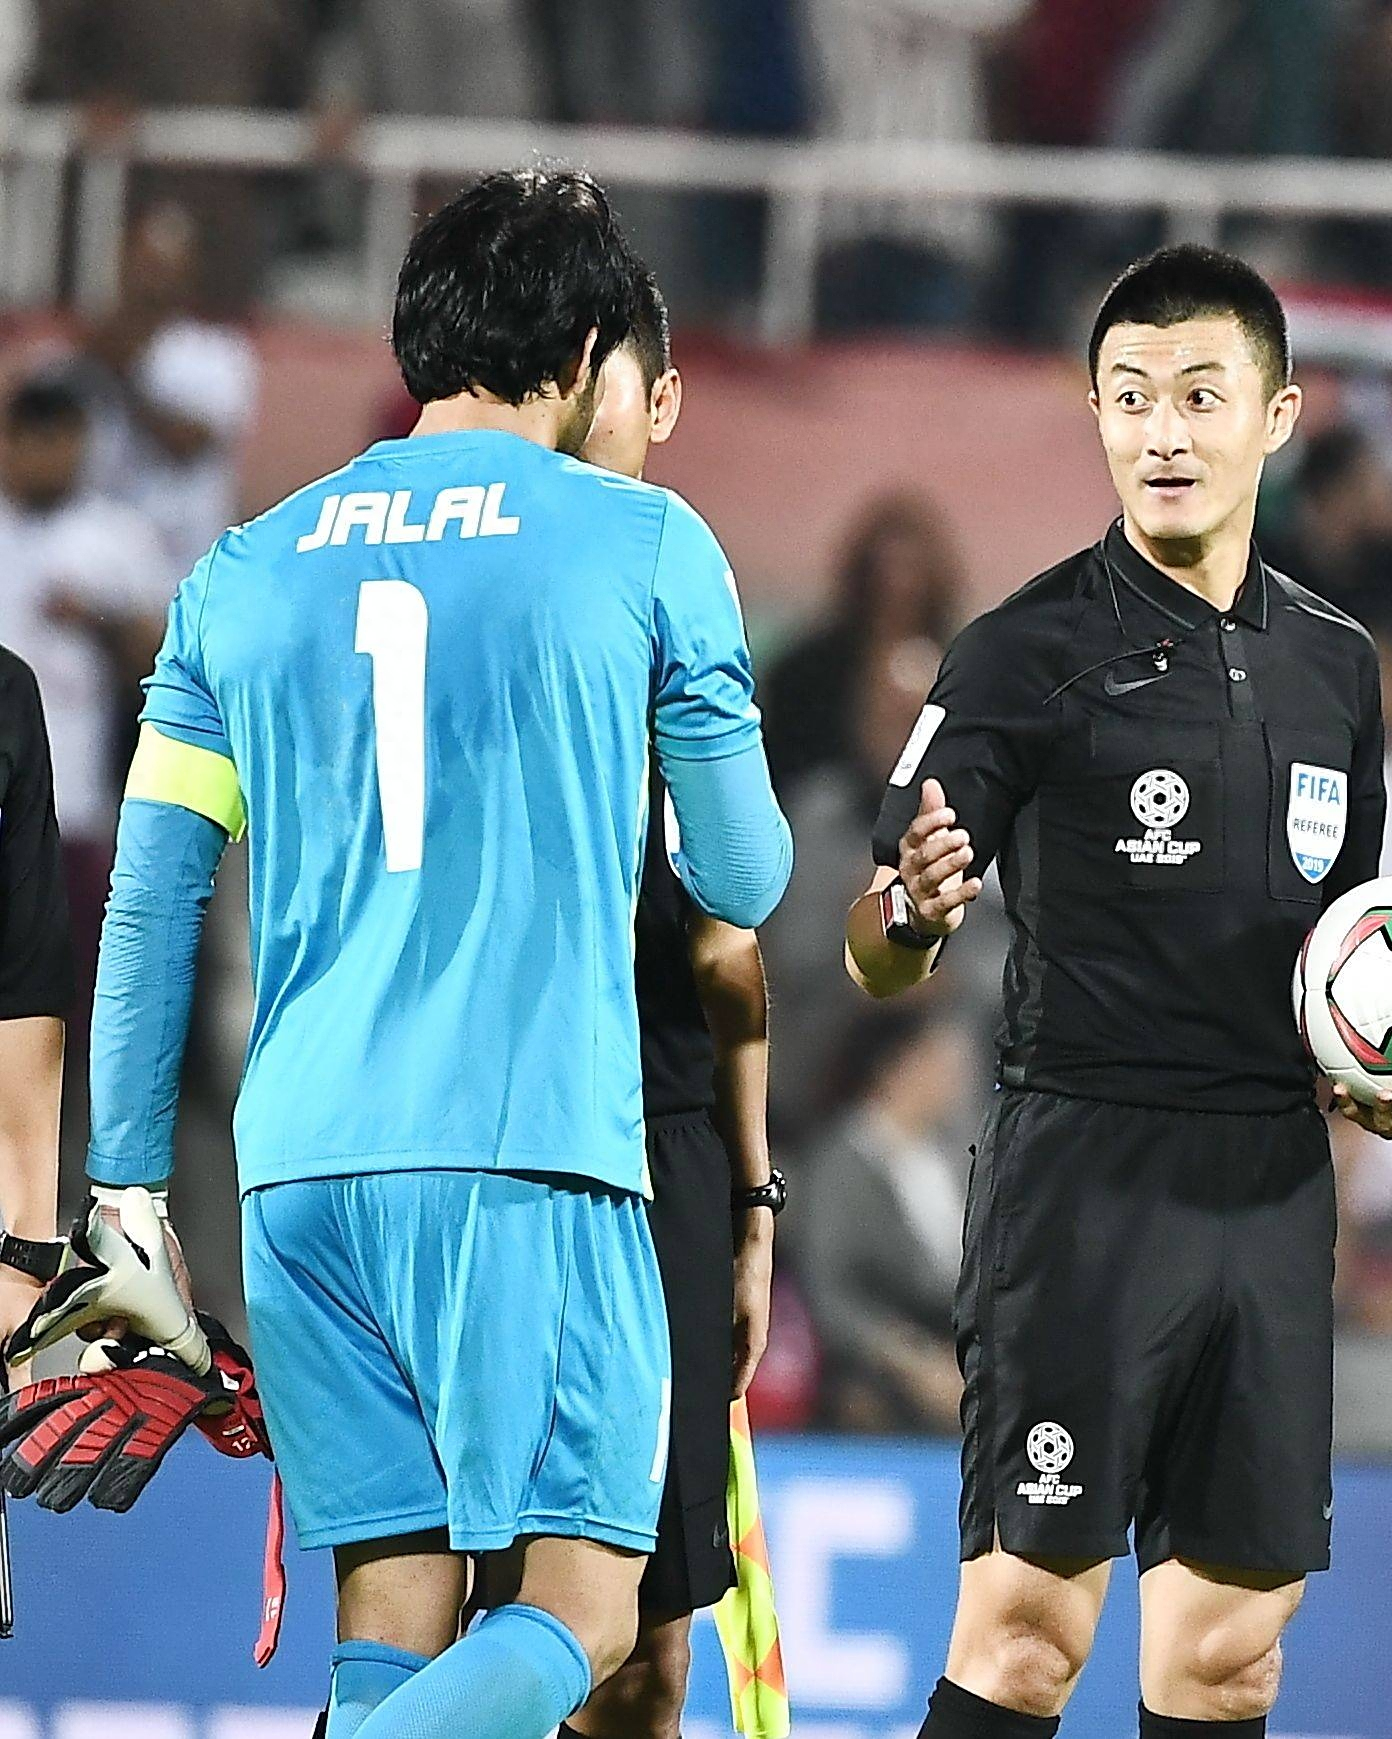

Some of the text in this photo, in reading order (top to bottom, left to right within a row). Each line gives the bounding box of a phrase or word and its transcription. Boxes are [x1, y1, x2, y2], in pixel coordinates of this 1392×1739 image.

[296, 482, 520, 553] JALAL
[354, 579, 429, 873] 1
[1298, 773, 1340, 805] FIFA
[1144, 828, 1172, 841] AFC
[1293, 818, 1338, 838] REFEREE
[1115, 838, 1201, 855] ASIAN CUP
[1055, 1484, 1083, 1497] CUP
